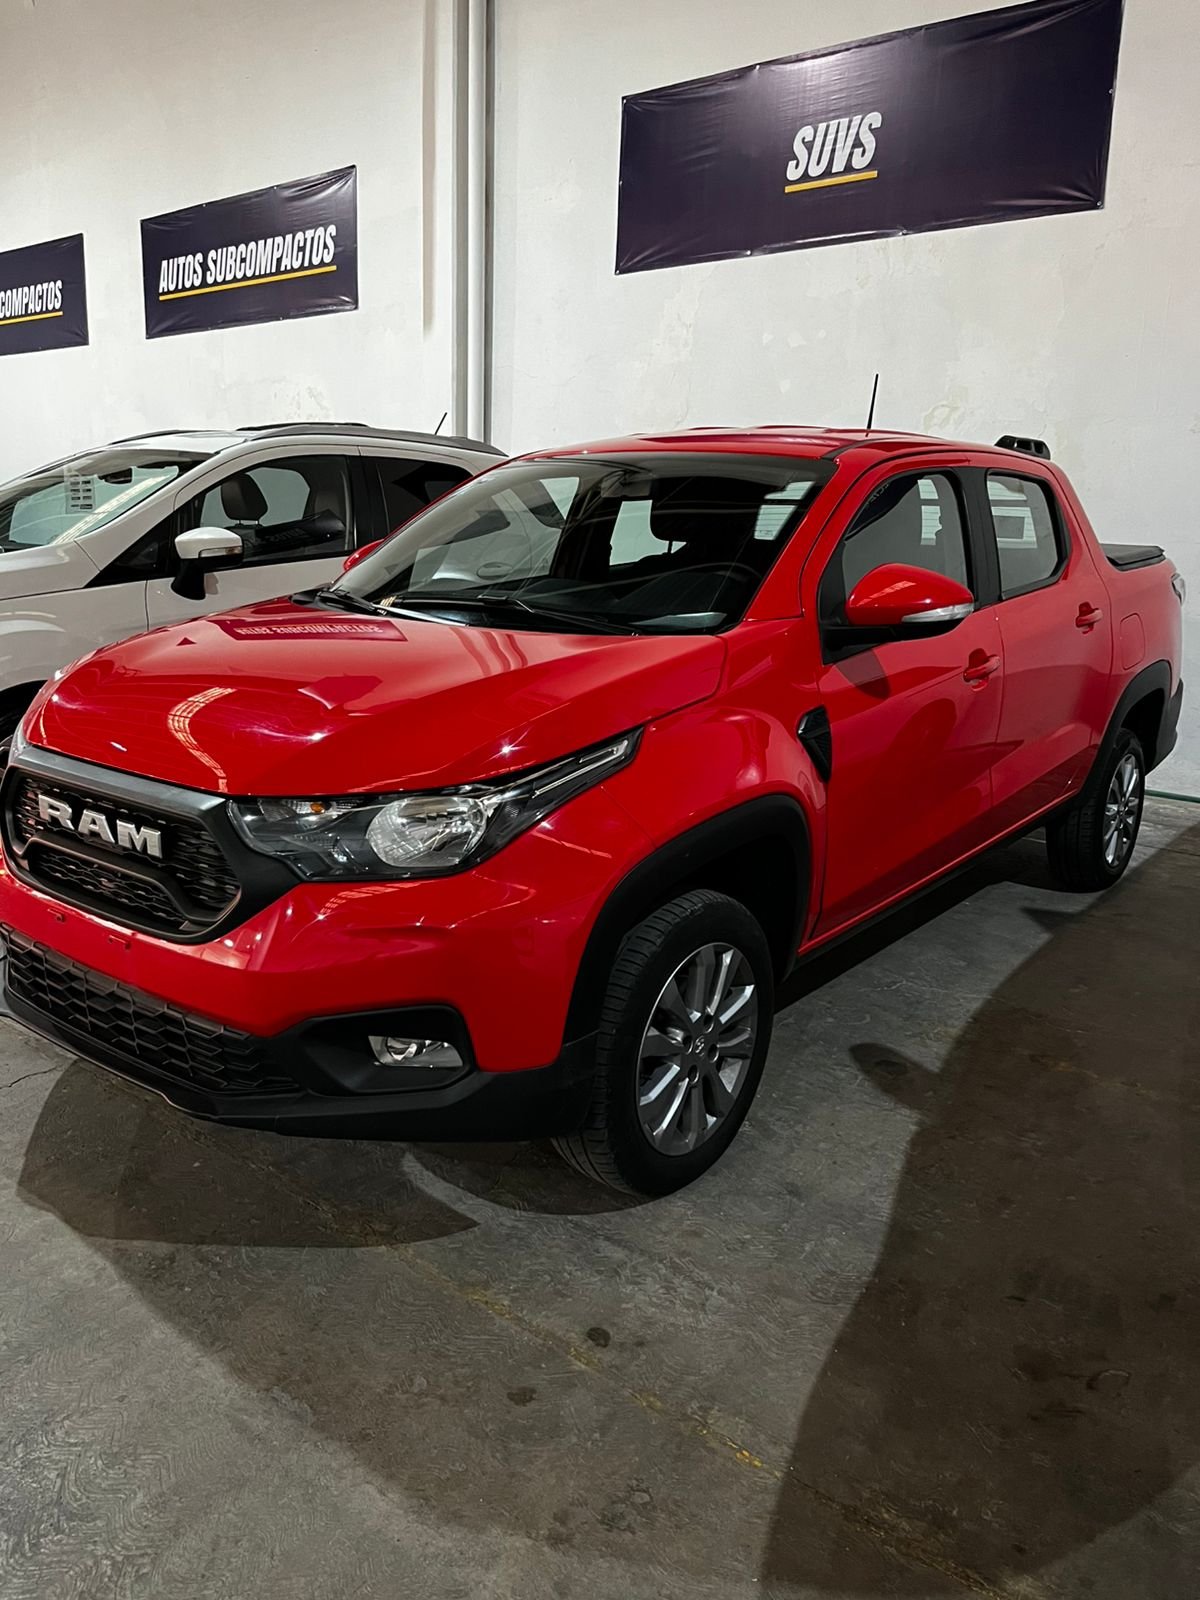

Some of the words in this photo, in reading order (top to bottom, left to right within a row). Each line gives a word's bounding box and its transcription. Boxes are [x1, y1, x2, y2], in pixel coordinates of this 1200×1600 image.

[786, 111, 882, 181] SUVS
[158, 252, 203, 293] AUTOS
[206, 224, 337, 285] SUBCOMPACTOS
[38, 794, 163, 859] RAM
